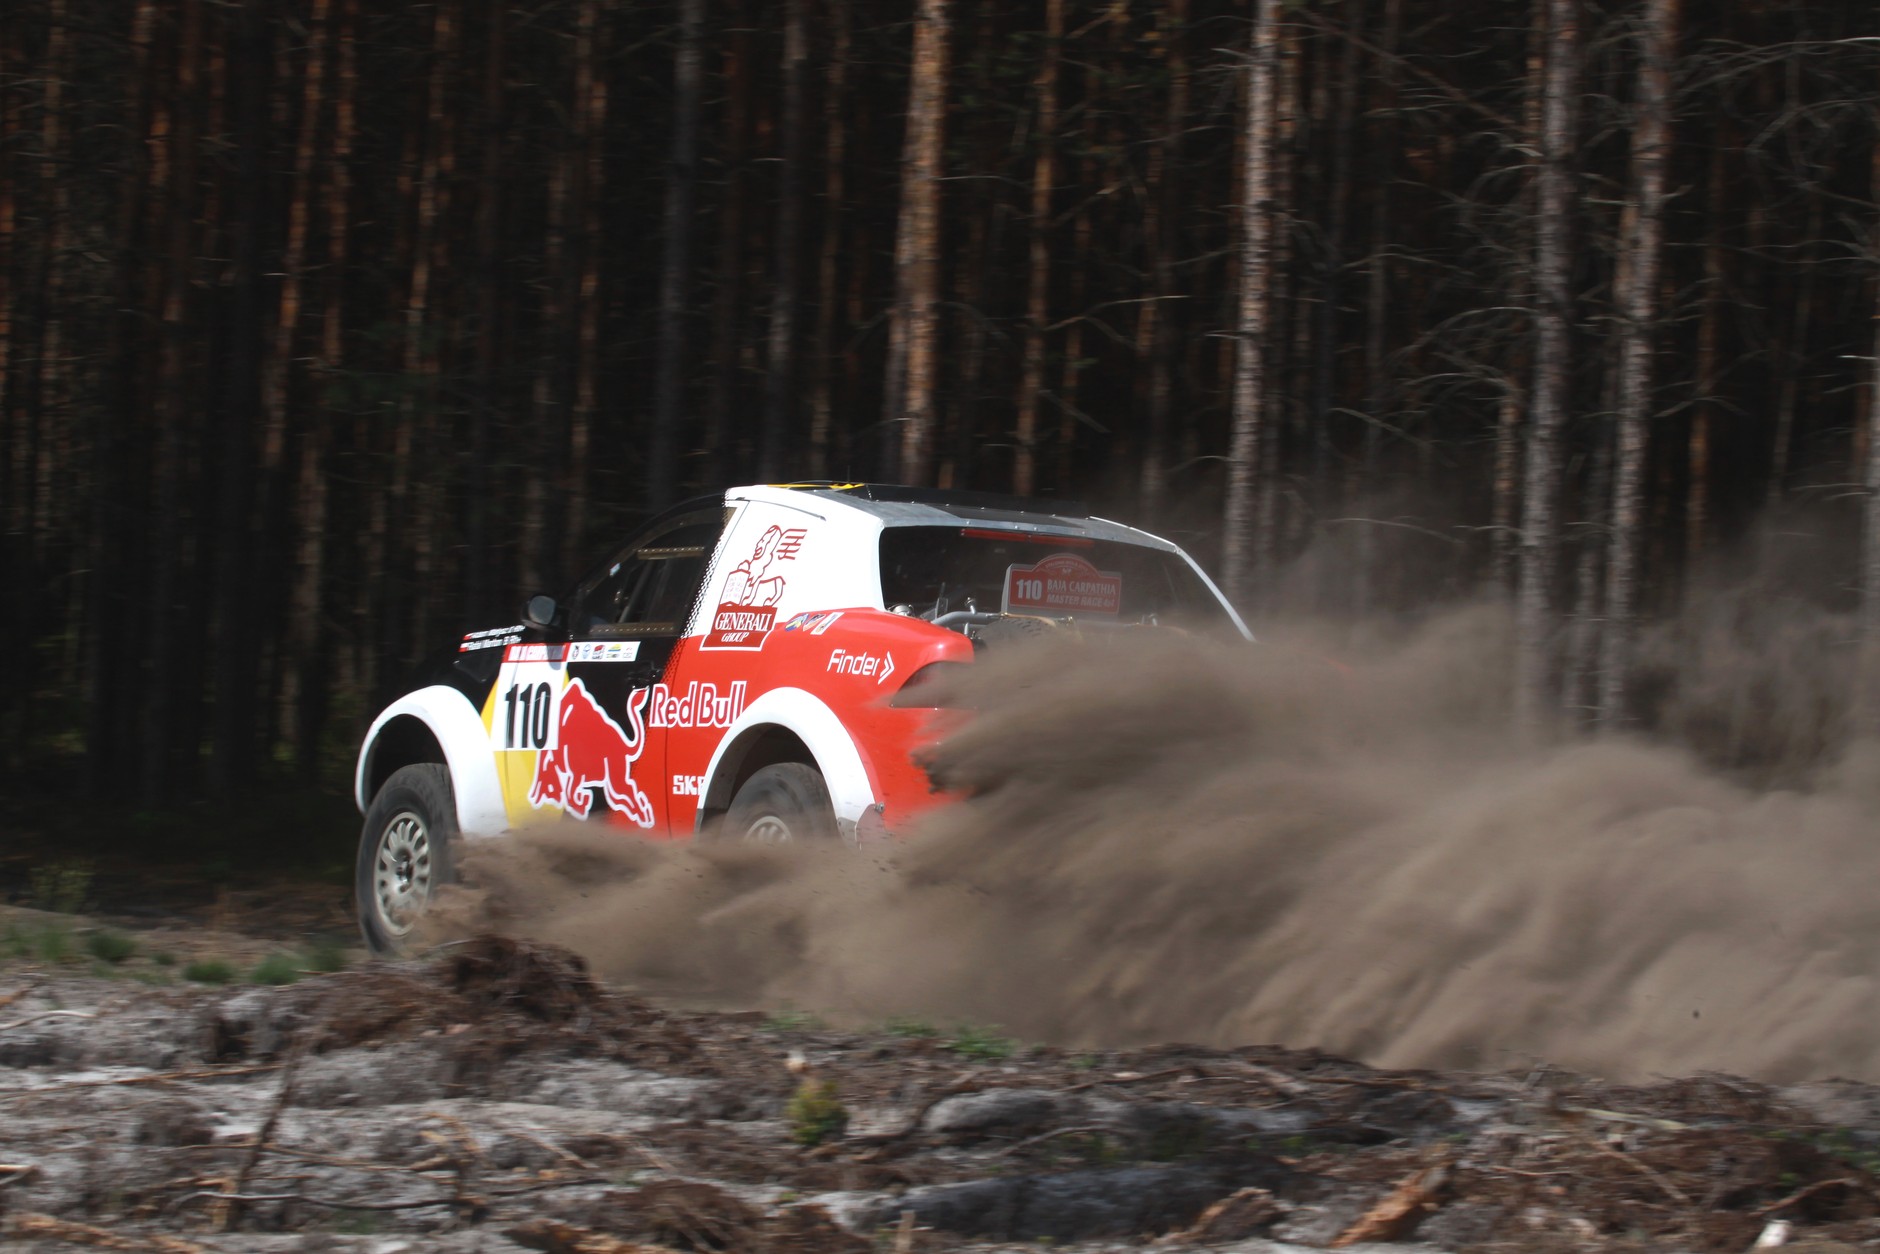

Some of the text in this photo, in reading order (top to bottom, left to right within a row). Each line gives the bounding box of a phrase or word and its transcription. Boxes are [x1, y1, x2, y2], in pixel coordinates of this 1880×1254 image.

[1016, 579, 1042, 600] 110
[1047, 579, 1116, 595] BAJA CARPATHIA
[1046, 594, 1080, 605] MASTER
[1081, 596, 1103, 607] RACE
[715, 612, 773, 632] GENERALI
[721, 631, 750, 643] GROUP
[827, 648, 881, 676] Finder
[505, 682, 552, 749] 110
